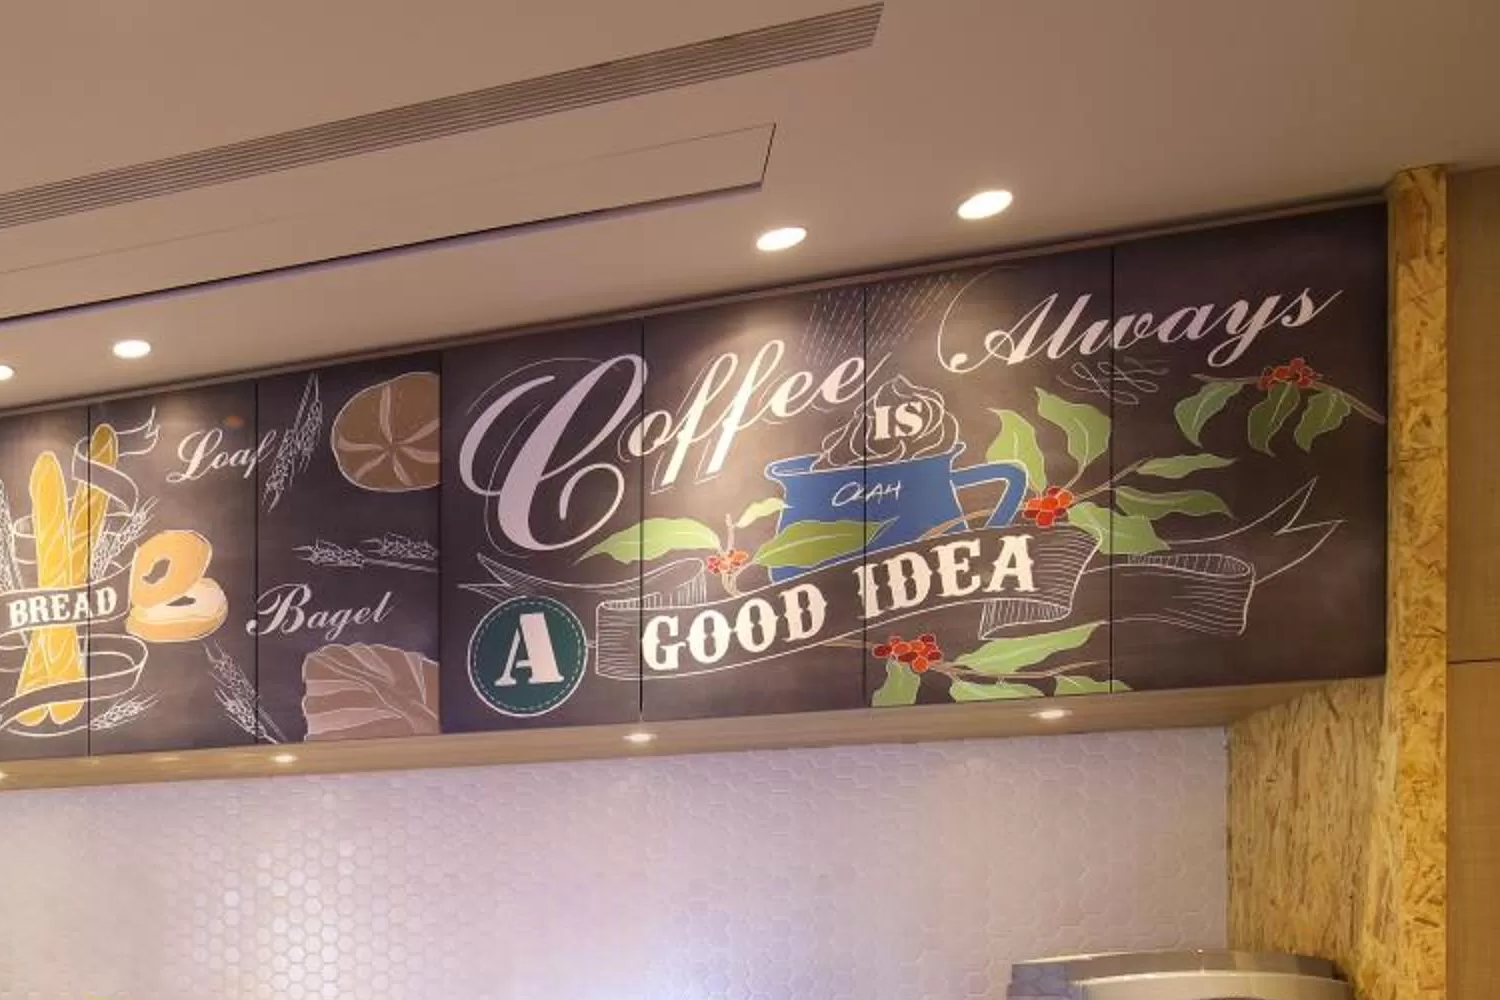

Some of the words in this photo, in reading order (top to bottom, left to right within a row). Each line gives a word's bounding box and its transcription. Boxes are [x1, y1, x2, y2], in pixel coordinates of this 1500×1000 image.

[937, 274, 1343, 372] Always
[460, 340, 891, 551] Coffee
[874, 401, 924, 440] IS
[166, 428, 277, 483] Loaf
[8, 587, 118, 628] BREAD
[246, 582, 394, 641] Bagel
[642, 583, 828, 671] GOOD
[853, 534, 1036, 620] IDEA
[494, 612, 564, 687] A
